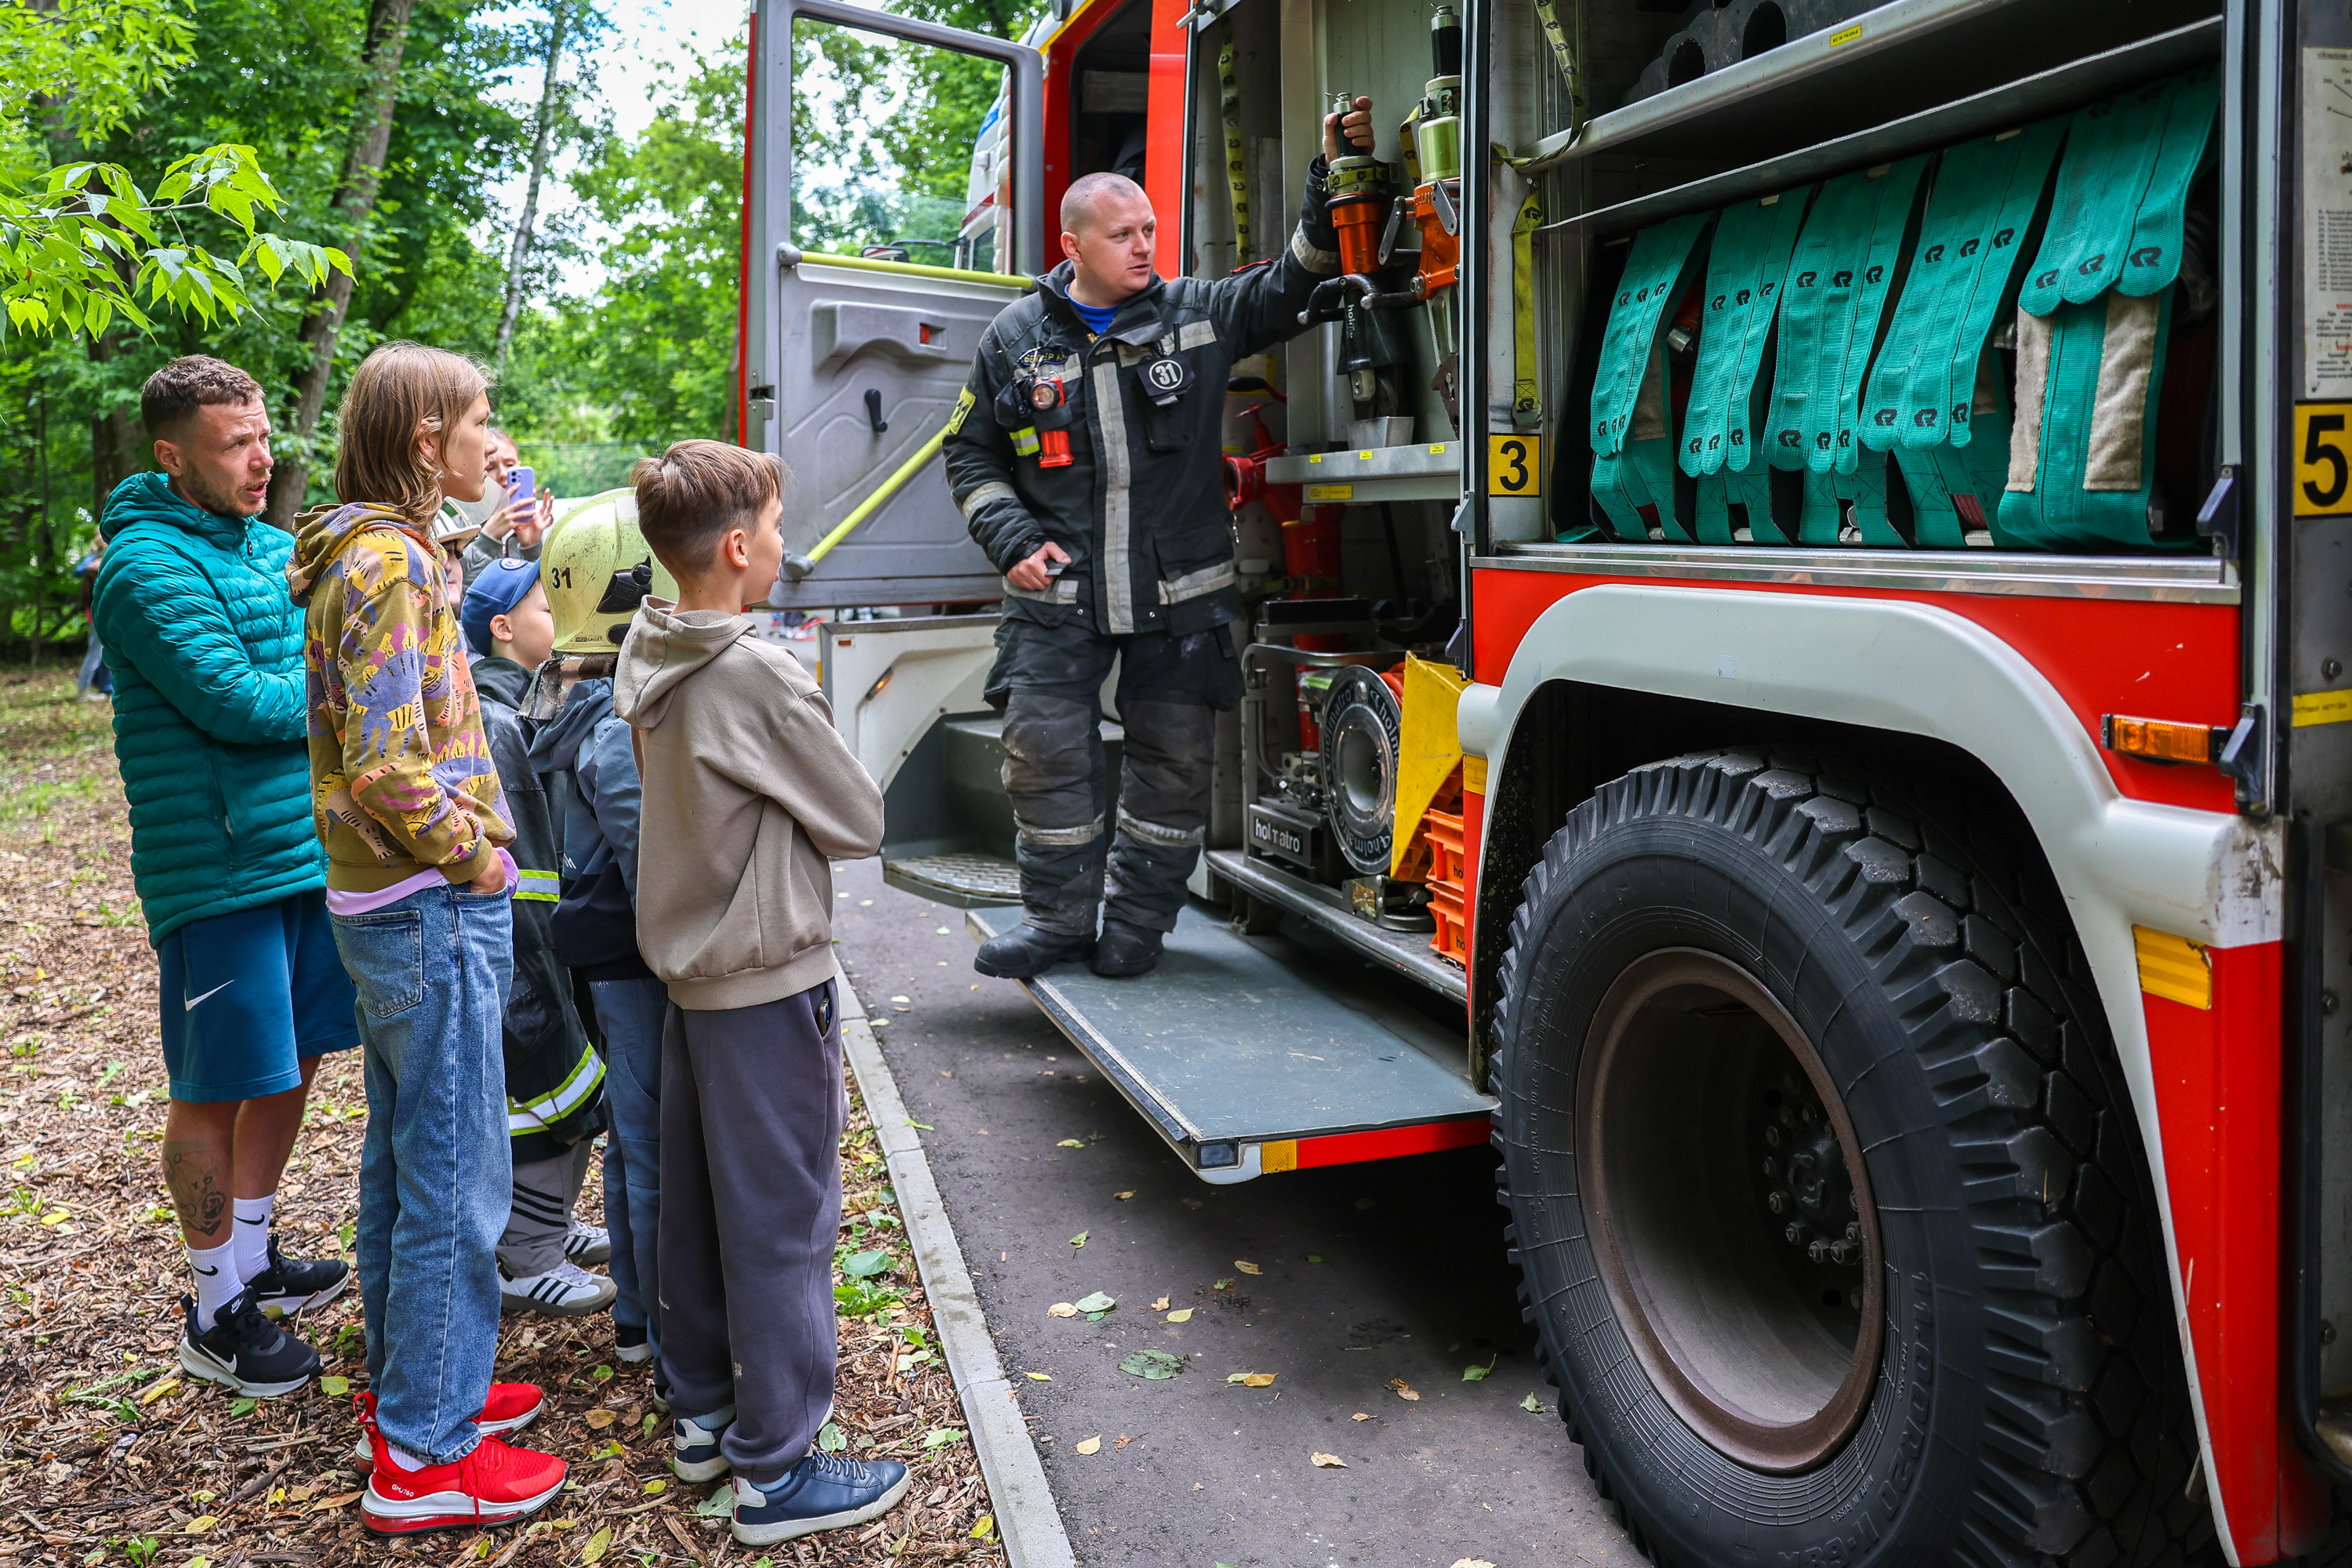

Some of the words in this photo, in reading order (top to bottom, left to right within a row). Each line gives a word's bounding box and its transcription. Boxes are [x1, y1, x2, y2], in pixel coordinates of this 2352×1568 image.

[1155, 363, 1178, 386] 31
[1499, 440, 1529, 492] 3
[2303, 414, 2349, 507] 5
[551, 568, 572, 589] 31
